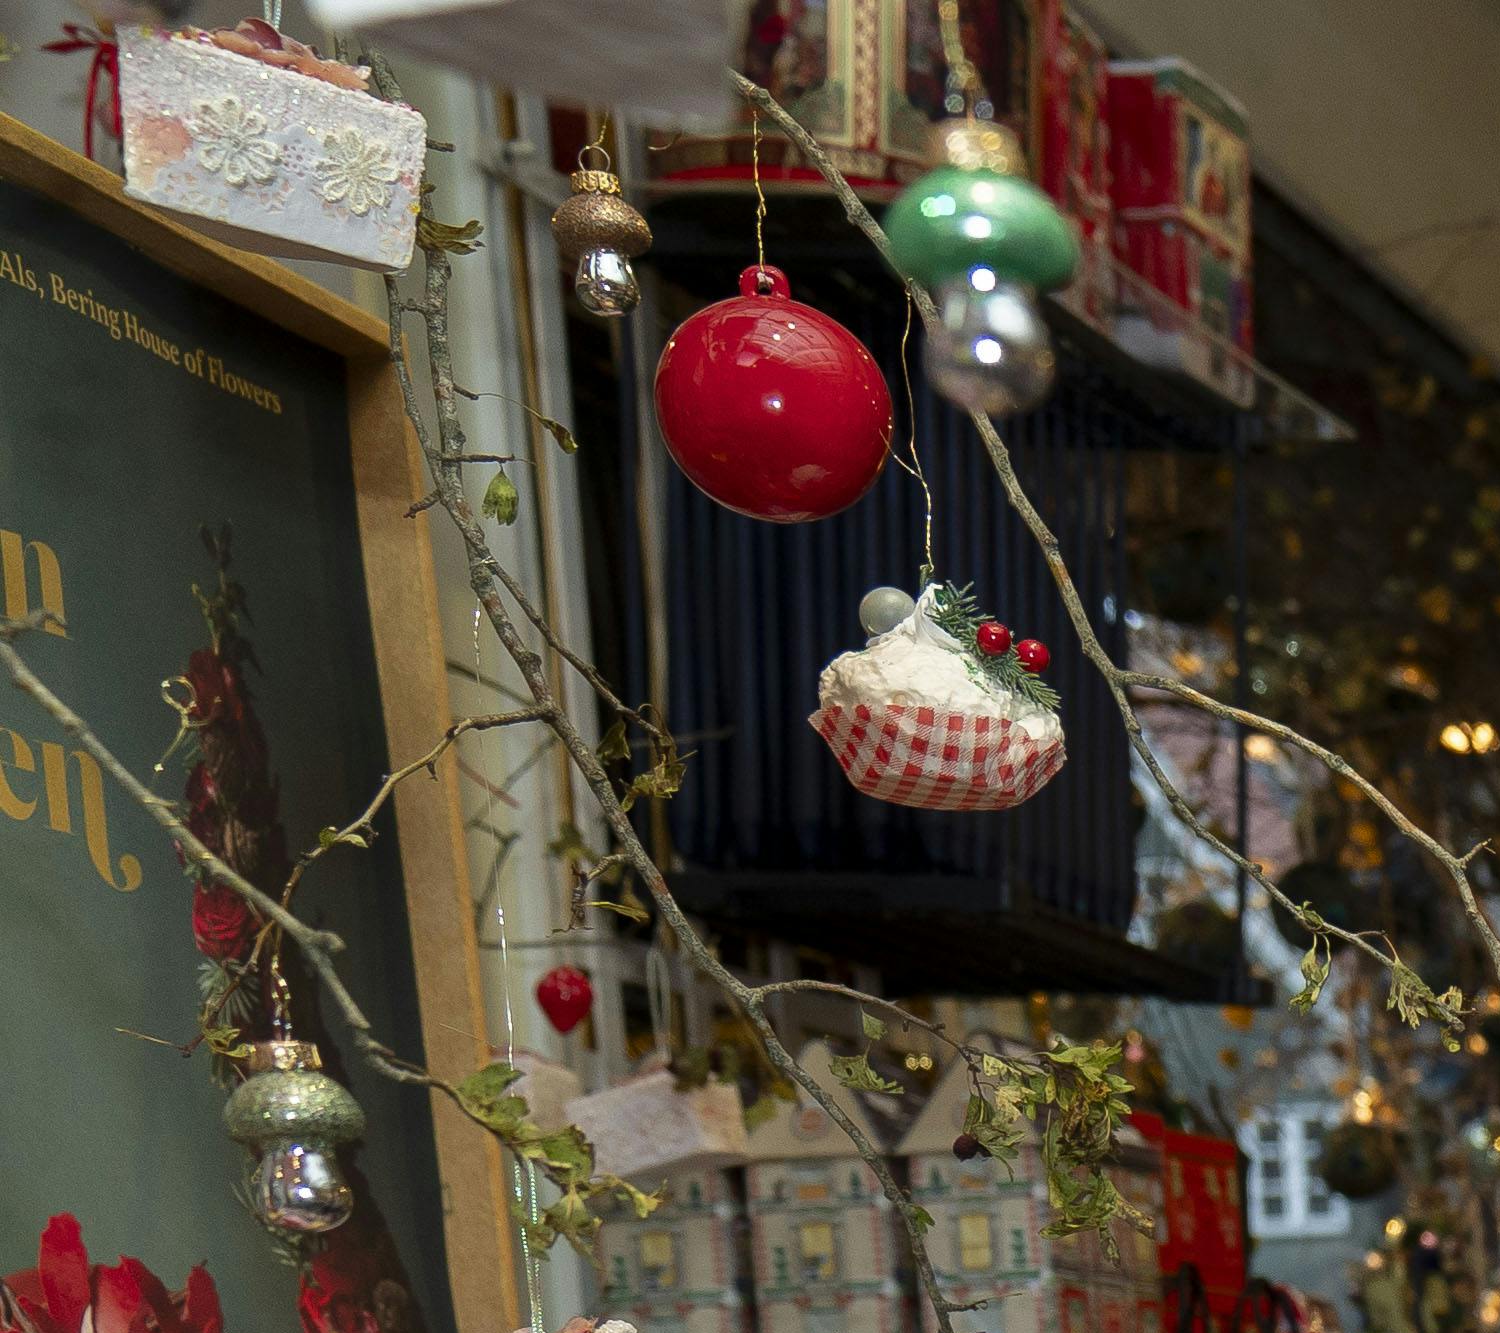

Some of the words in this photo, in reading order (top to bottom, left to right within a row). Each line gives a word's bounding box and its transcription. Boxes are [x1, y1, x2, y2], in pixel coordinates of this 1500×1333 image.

[0, 252, 45, 299] Als,
[49, 272, 121, 340] Bering
[123, 311, 180, 366] House
[184, 348, 205, 378] of
[207, 356, 282, 415] Flowers
